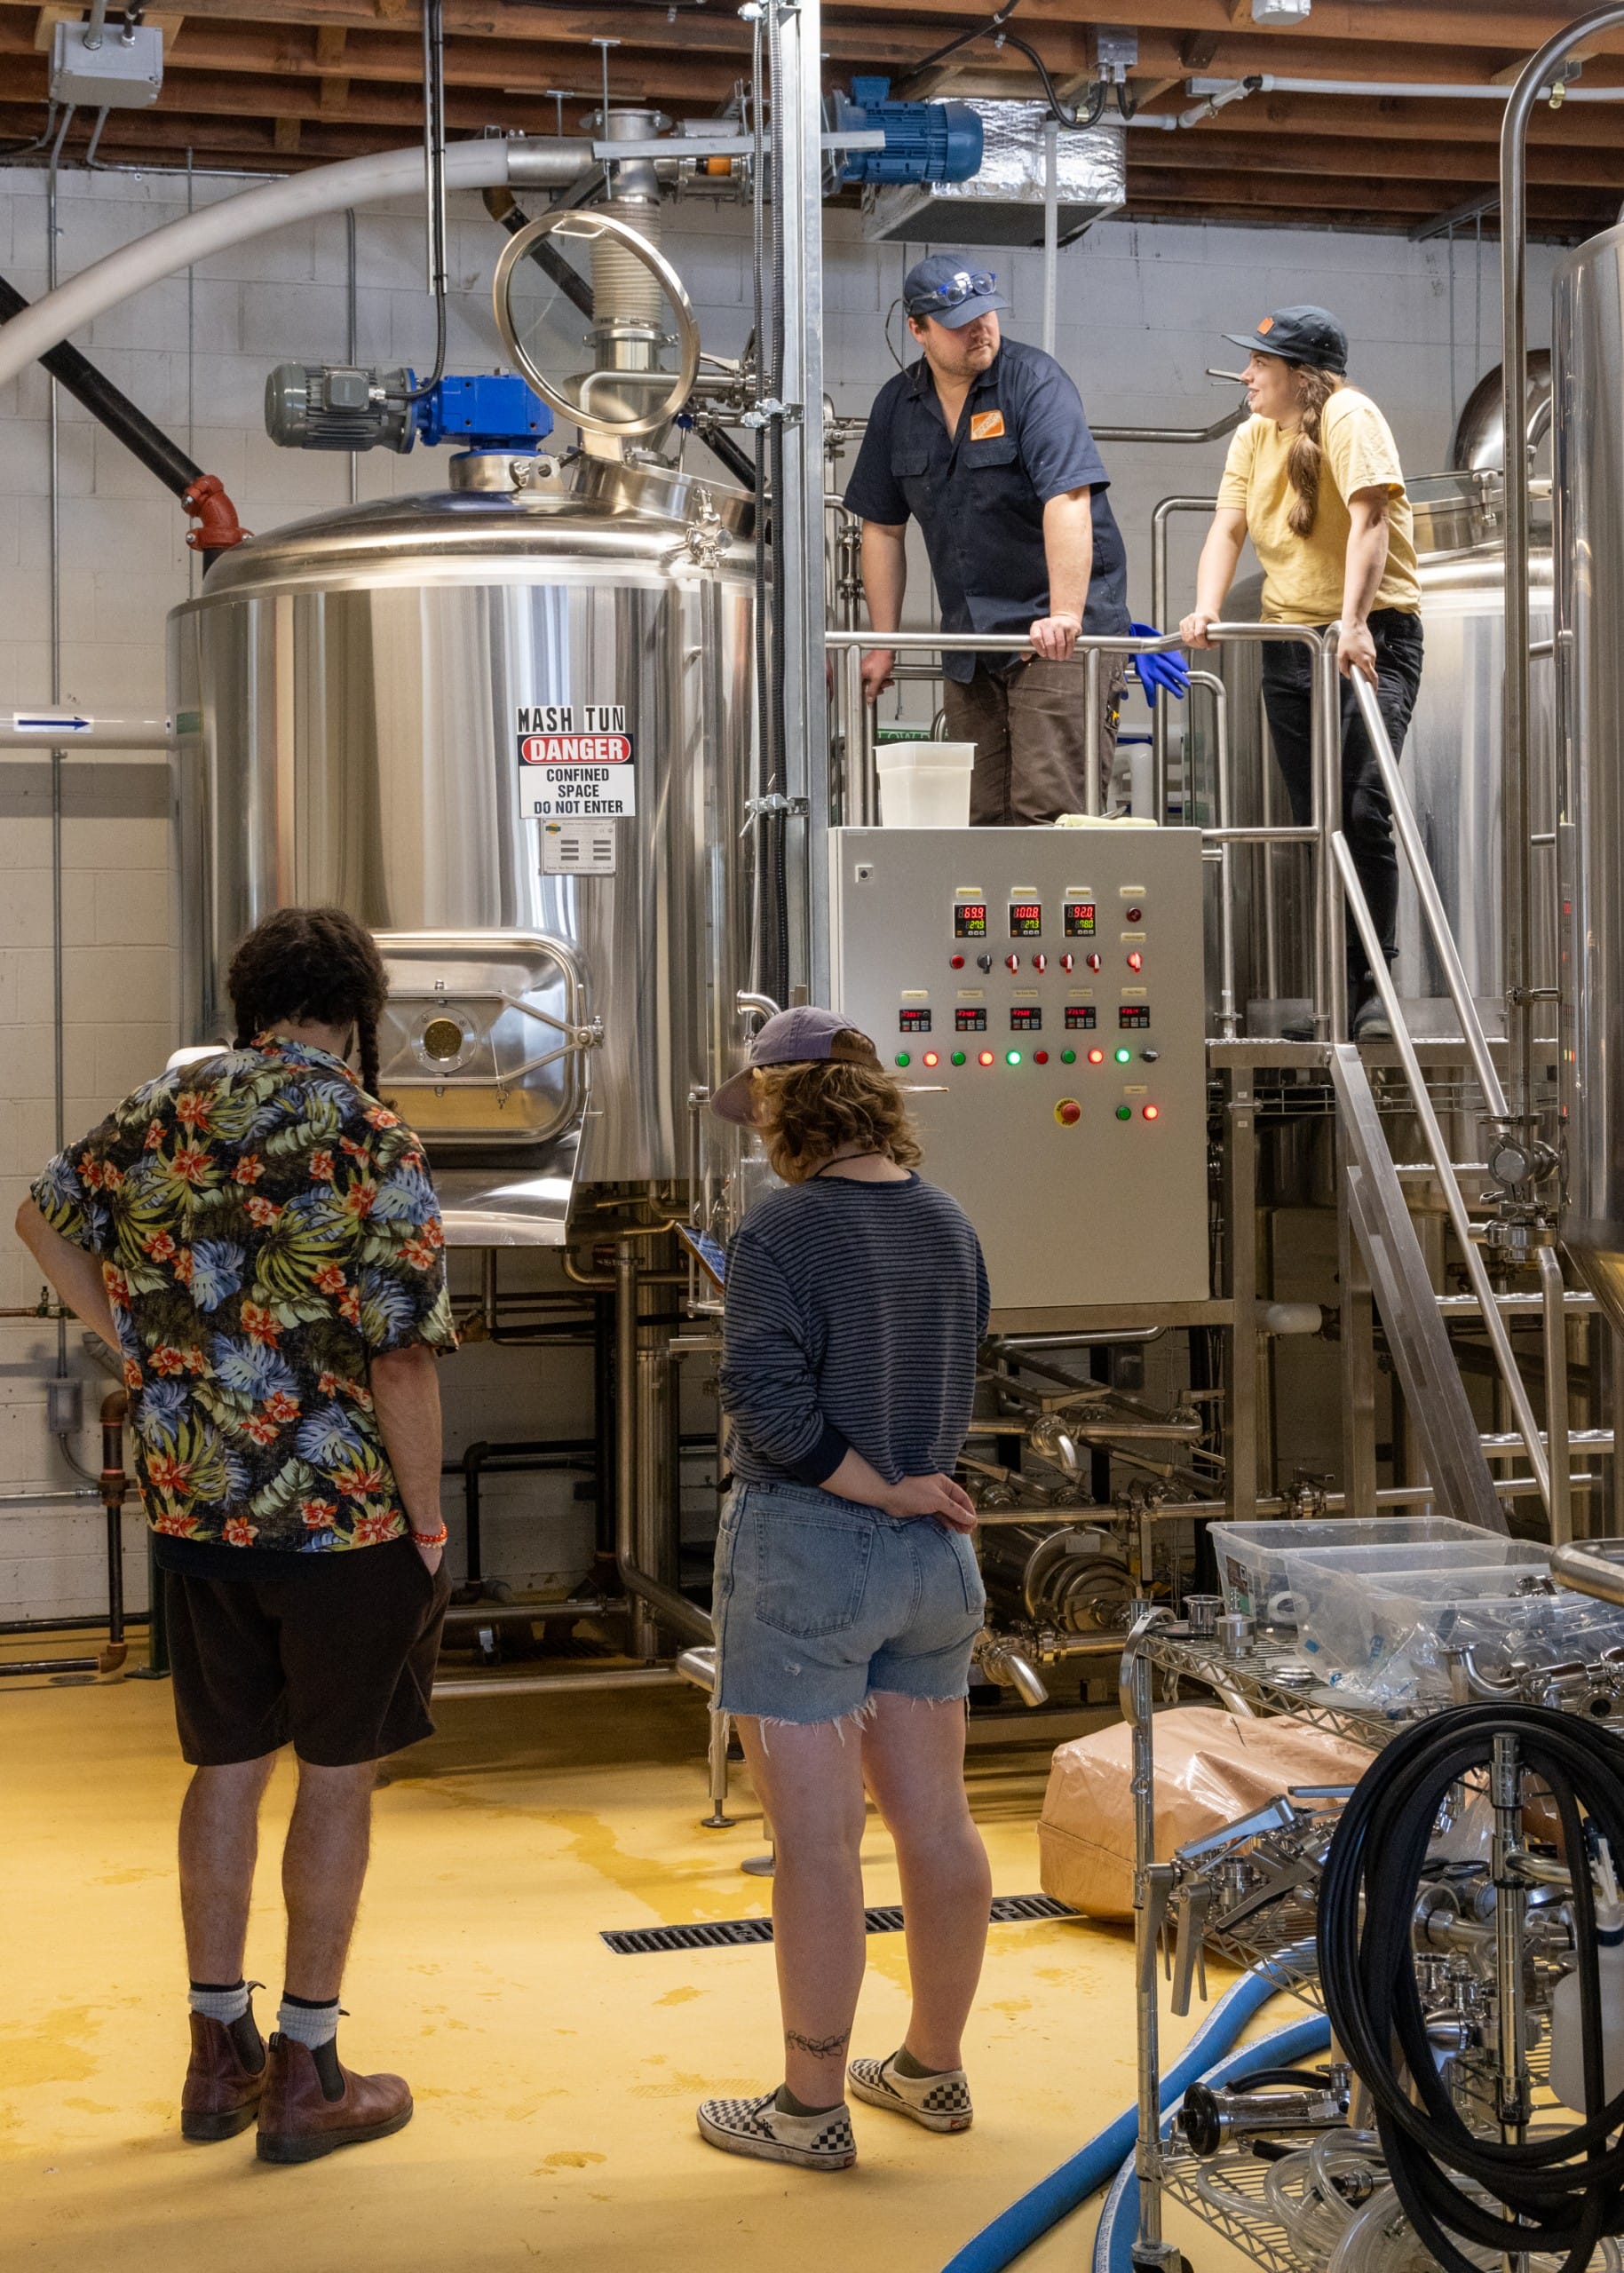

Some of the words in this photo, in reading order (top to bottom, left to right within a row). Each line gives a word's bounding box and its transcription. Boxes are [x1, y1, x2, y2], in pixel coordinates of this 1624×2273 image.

[518, 707, 573, 733] MASH
[585, 707, 624, 732] TUN
[530, 738, 623, 761] DANGER
[547, 768, 609, 782] CONFINED
[558, 784, 599, 798] SPACE
[535, 801, 551, 814] DO
[556, 801, 580, 814] NOT
[584, 800, 623, 813] ENTER
